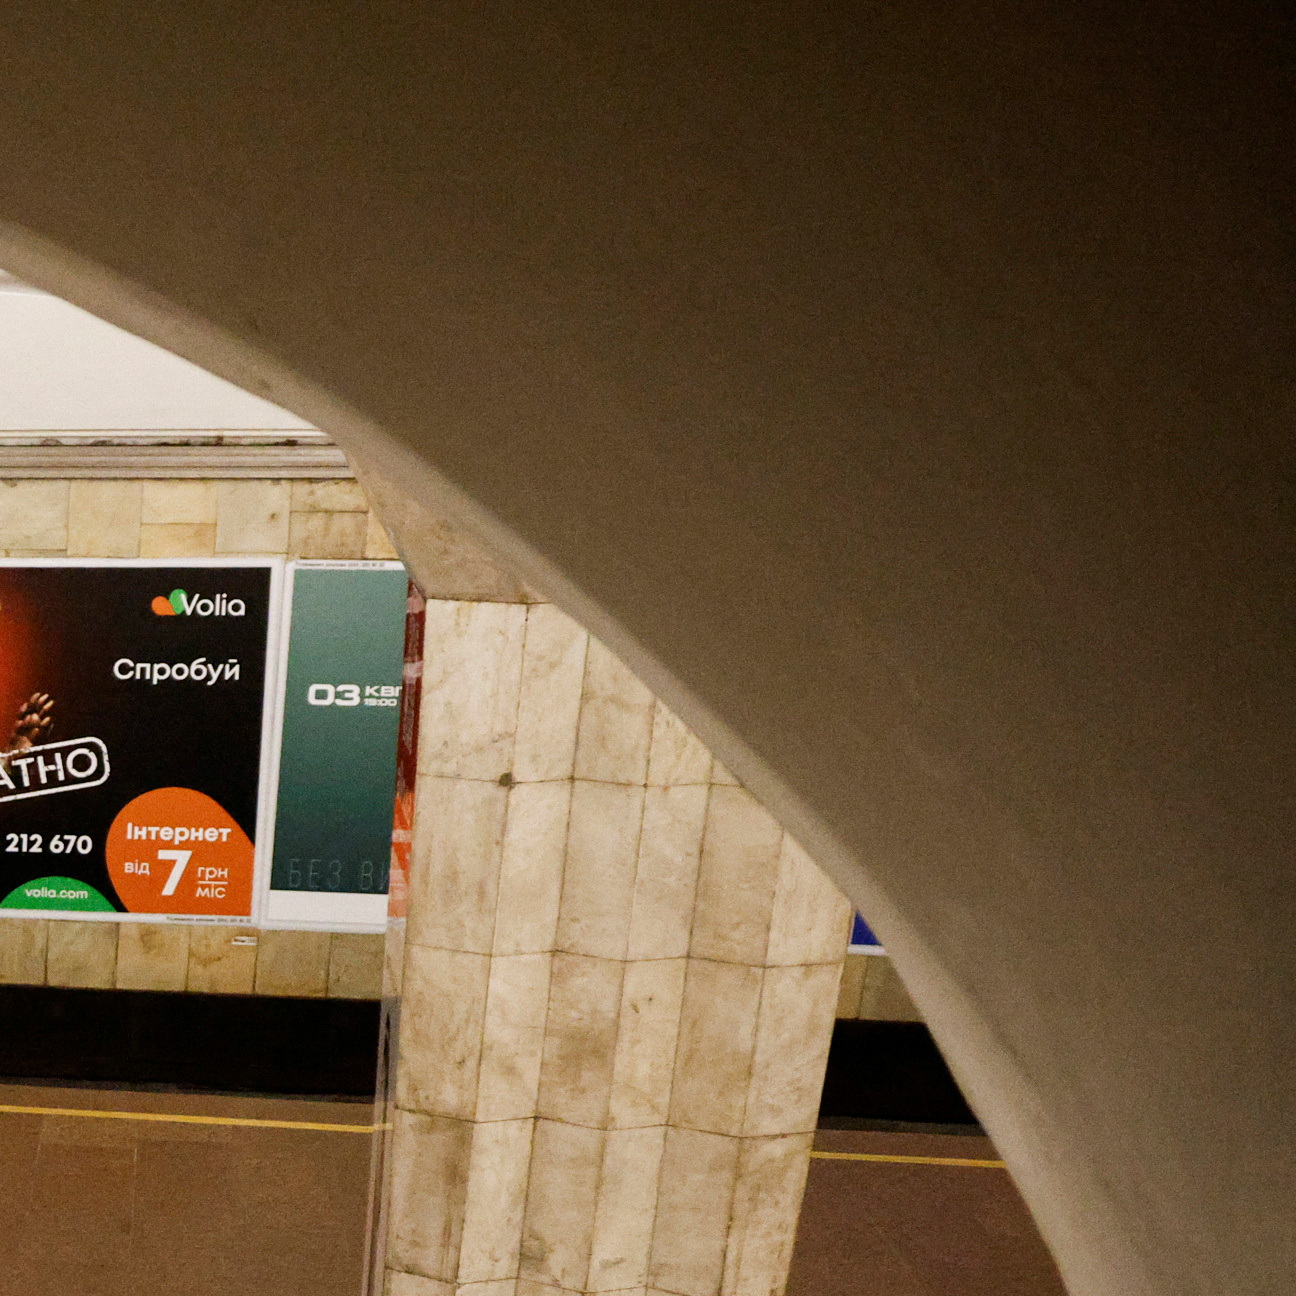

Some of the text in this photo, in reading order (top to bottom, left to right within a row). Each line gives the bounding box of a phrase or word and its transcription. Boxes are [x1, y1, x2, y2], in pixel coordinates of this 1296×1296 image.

[180, 593, 246, 617] Volia
[112, 657, 241, 686] Спробуй
[308, 683, 361, 707] 03
[5, 833, 43, 854] 212
[49, 835, 93, 855] 670
[127, 822, 232, 845] Інтернет
[124, 849, 228, 896] від 7 грн
[288, 858, 342, 889] БЕЗ
[25, 886, 89, 899] volia.com
[195, 883, 226, 899] міс
